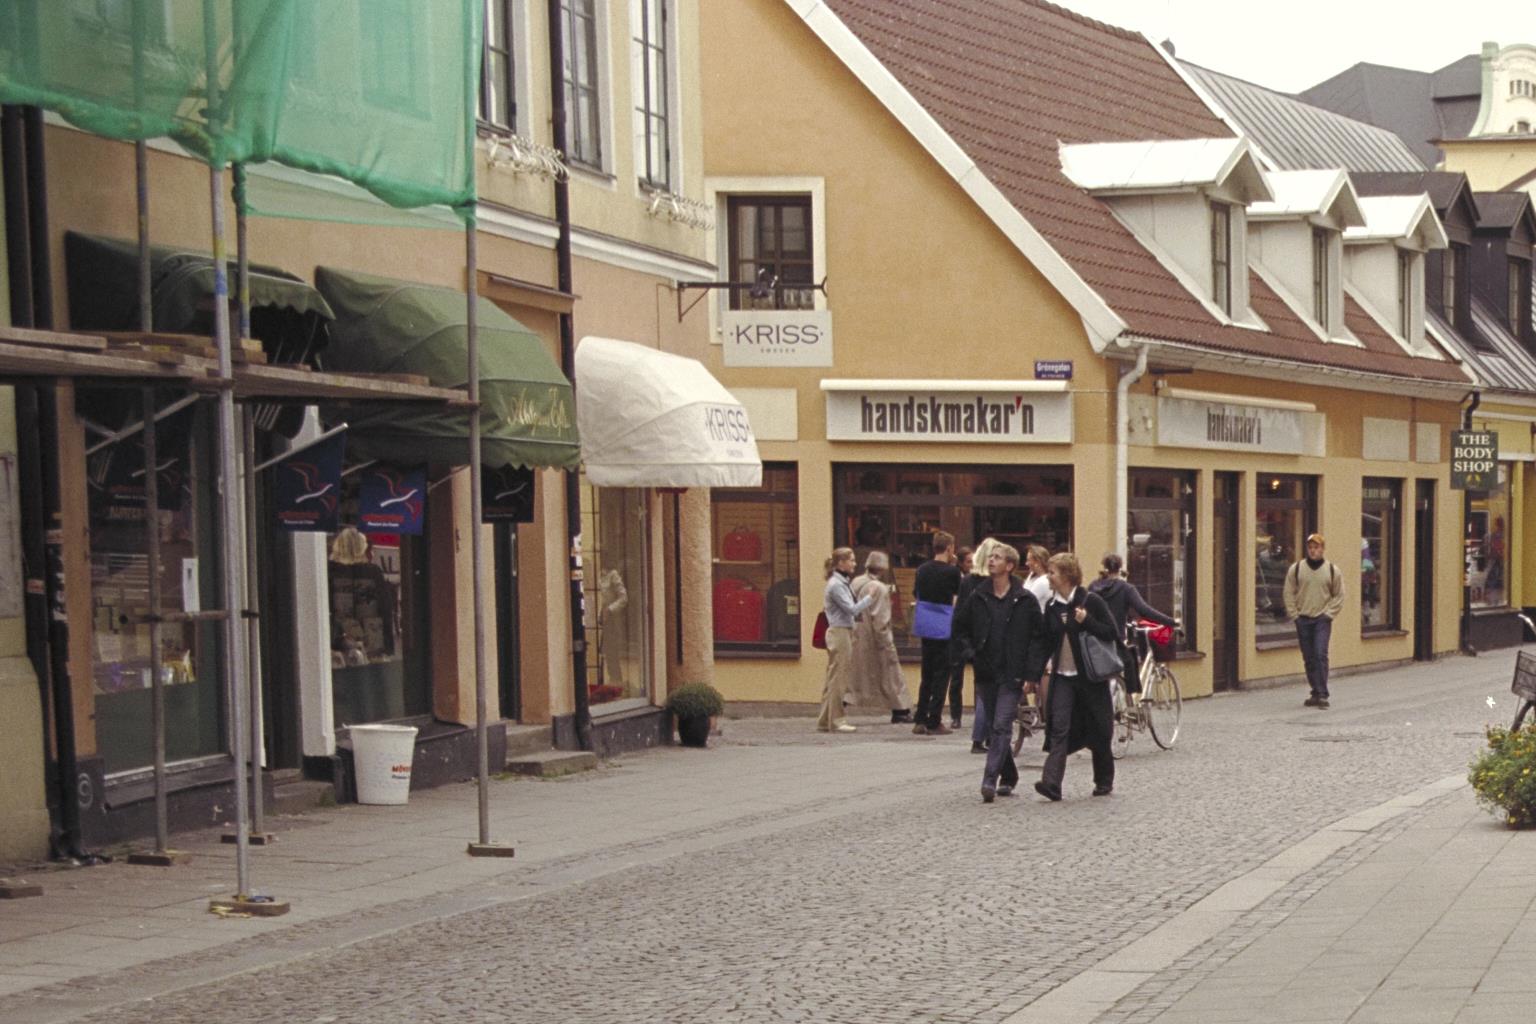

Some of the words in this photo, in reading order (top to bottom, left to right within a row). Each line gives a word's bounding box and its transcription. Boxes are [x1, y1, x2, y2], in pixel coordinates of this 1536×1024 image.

[736, 324, 819, 345] KRISS
[861, 395, 1035, 435] handskmakar'n
[704, 407, 749, 443] KRISS
[1459, 434, 1491, 446] THE
[1454, 447, 1495, 459] BODY
[1453, 461, 1494, 473] SHOP
